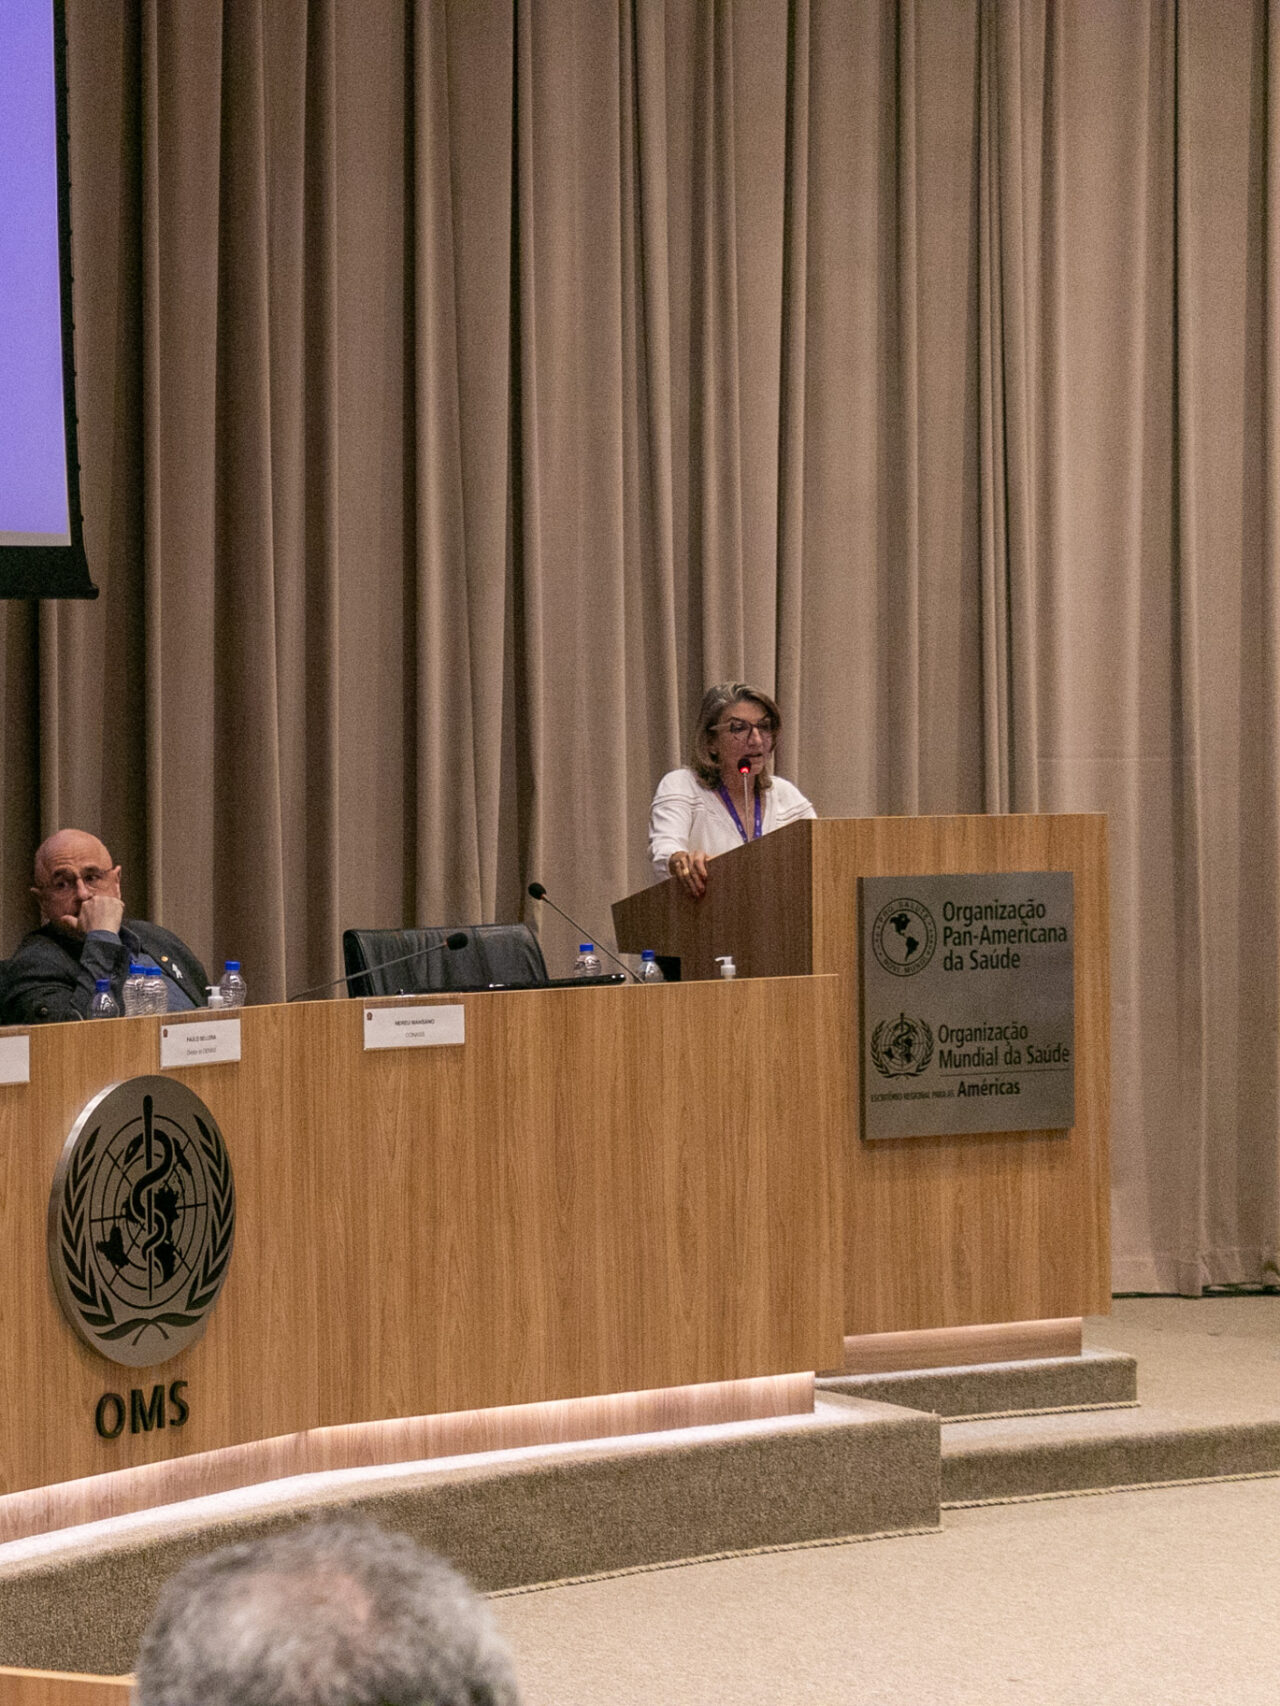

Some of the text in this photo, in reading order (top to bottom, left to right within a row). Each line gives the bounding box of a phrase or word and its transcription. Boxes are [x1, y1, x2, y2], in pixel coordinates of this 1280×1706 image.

[942, 898, 1046, 928] Organização
[942, 923, 1068, 947] Pan-Americana
[942, 947, 1021, 972] da Saúde
[937, 1021, 1029, 1049] Organização
[938, 1042, 1071, 1069] Mundial da Saúde
[956, 1078, 1021, 1098] Américas
[94, 1380, 190, 1440] OMS
